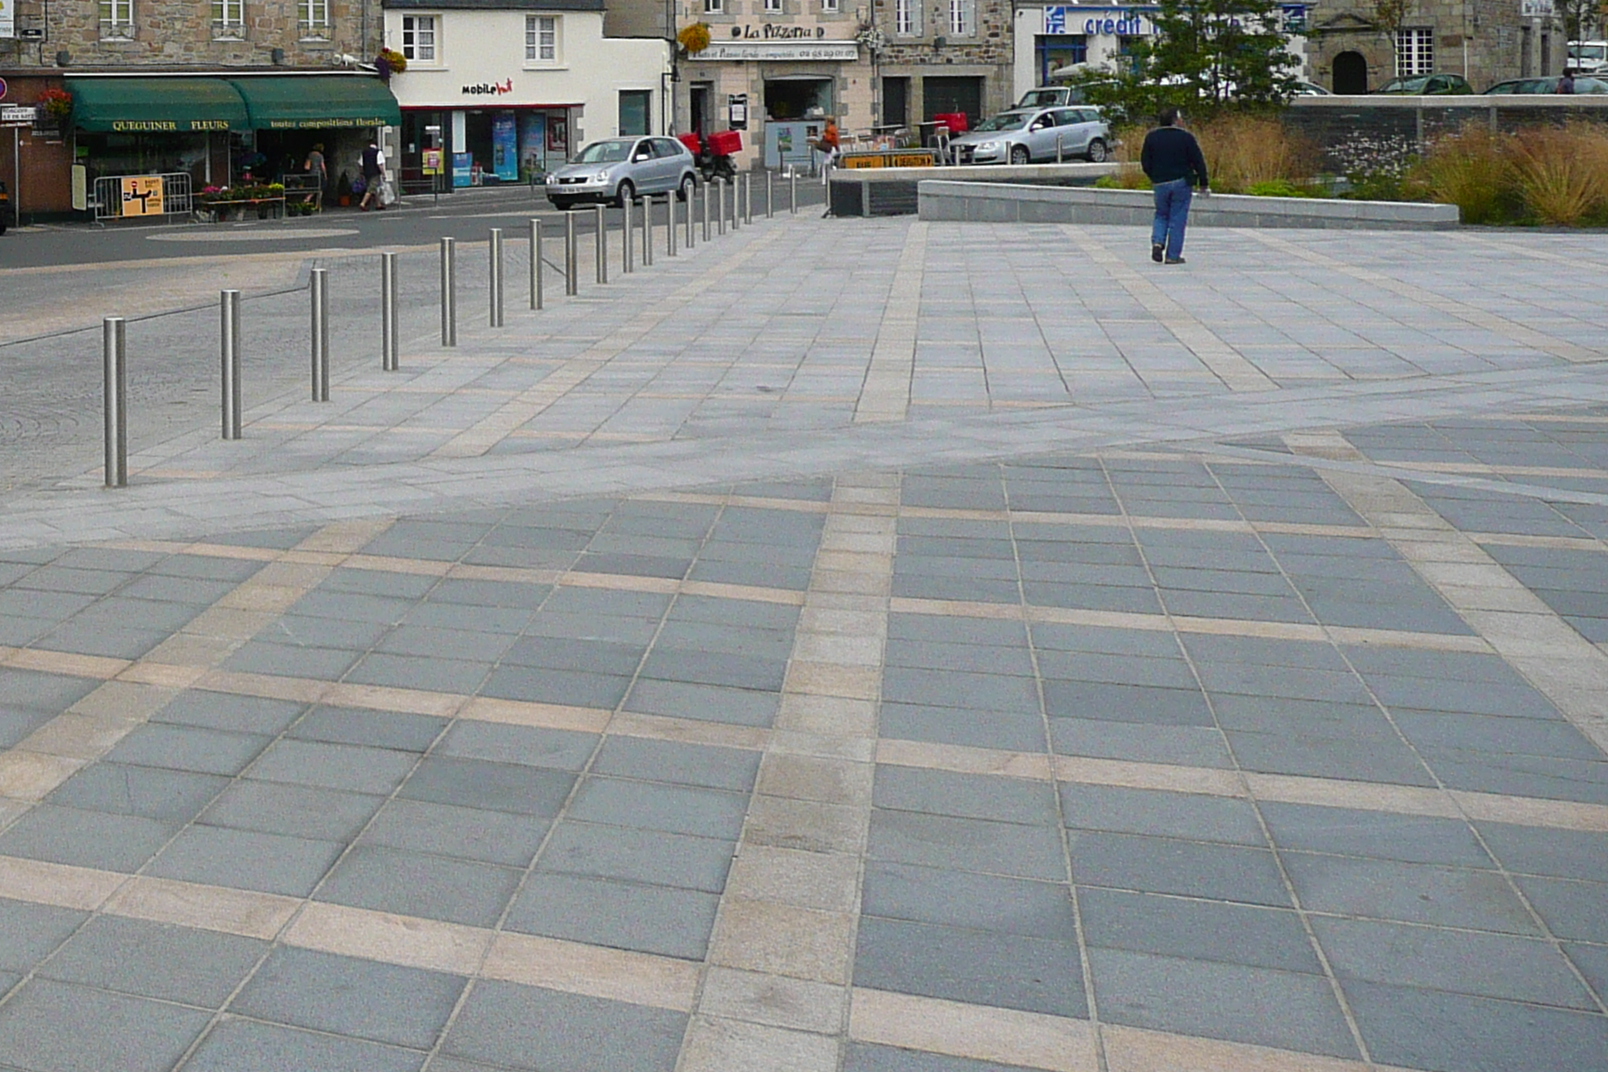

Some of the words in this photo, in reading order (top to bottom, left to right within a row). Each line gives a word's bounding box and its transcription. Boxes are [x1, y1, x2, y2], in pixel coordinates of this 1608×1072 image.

[744, 24, 760, 39] La
[763, 23, 812, 39] Pizzeria
[112, 121, 177, 131] QUEGUINER
[191, 120, 230, 130] FLEURS
[270, 120, 296, 128] toutes
[299, 118, 354, 129] compositions
